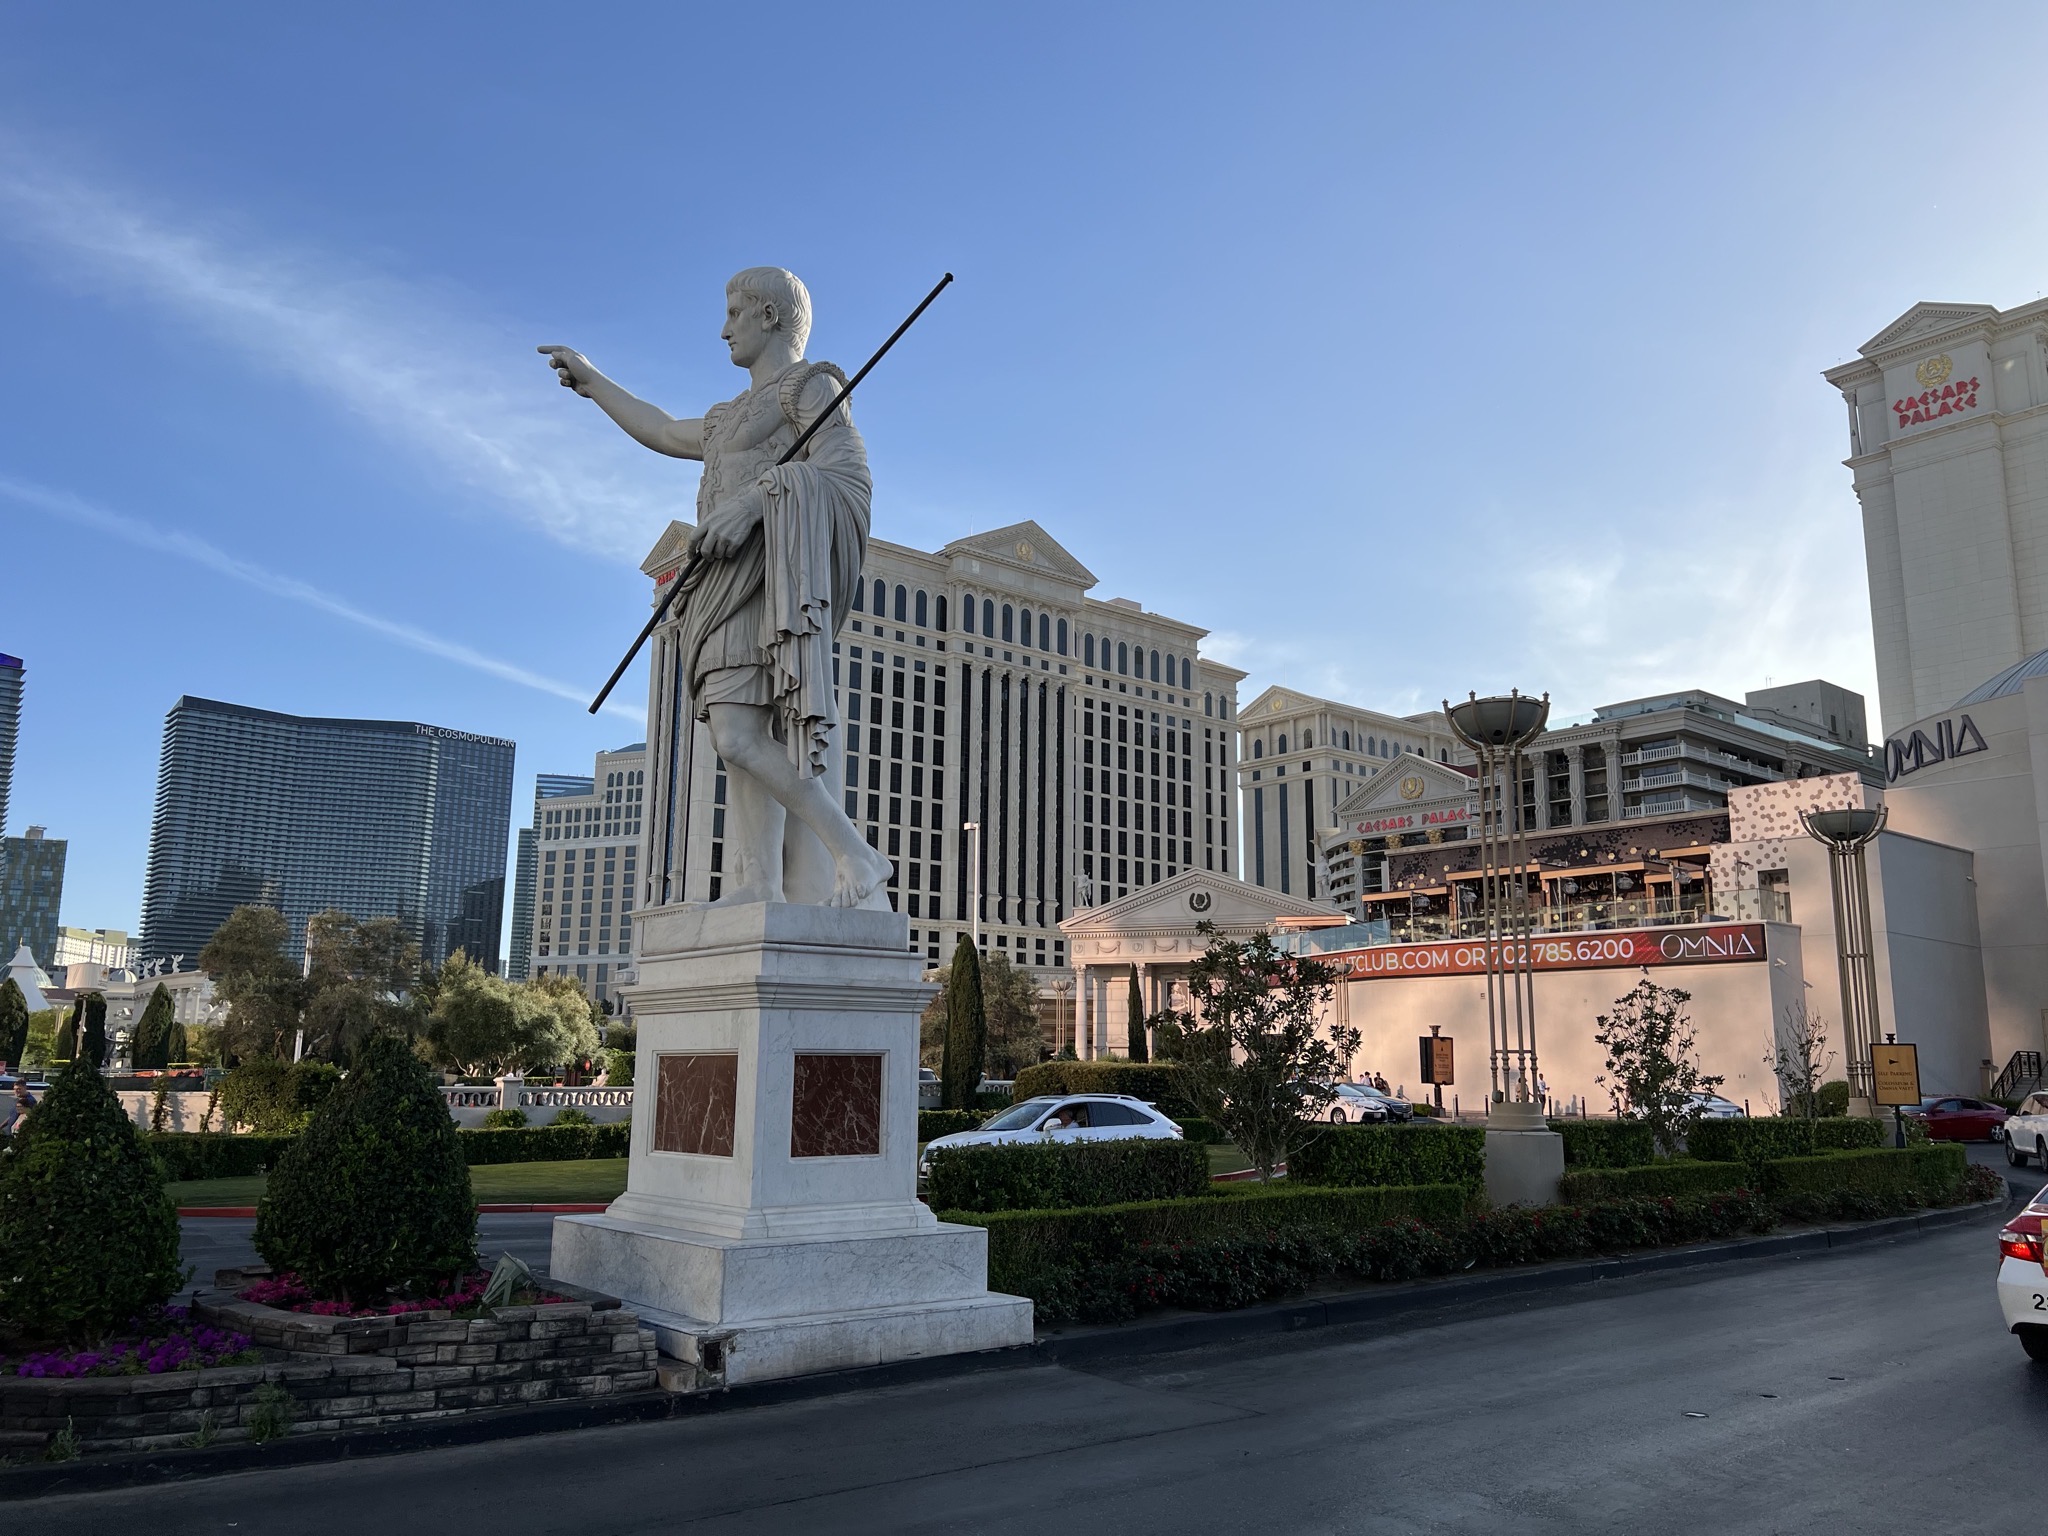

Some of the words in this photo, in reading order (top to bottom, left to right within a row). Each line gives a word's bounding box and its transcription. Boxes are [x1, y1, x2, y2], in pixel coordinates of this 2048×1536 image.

[1893, 377, 1980, 414] CAESARS
[1899, 393, 1977, 429] PALACE
[415, 724, 435, 736] THE
[438, 728, 515, 748] COSMOPOLITAN
[1884, 714, 1988, 783] OMNIA
[1357, 815, 1414, 834] CAESARS
[1454, 947, 1487, 967] OR
[1491, 938, 1634, 965] 702.785.6200
[1660, 933, 1755, 959] OMNIA
[2032, 1293, 2048, 1311] 2
